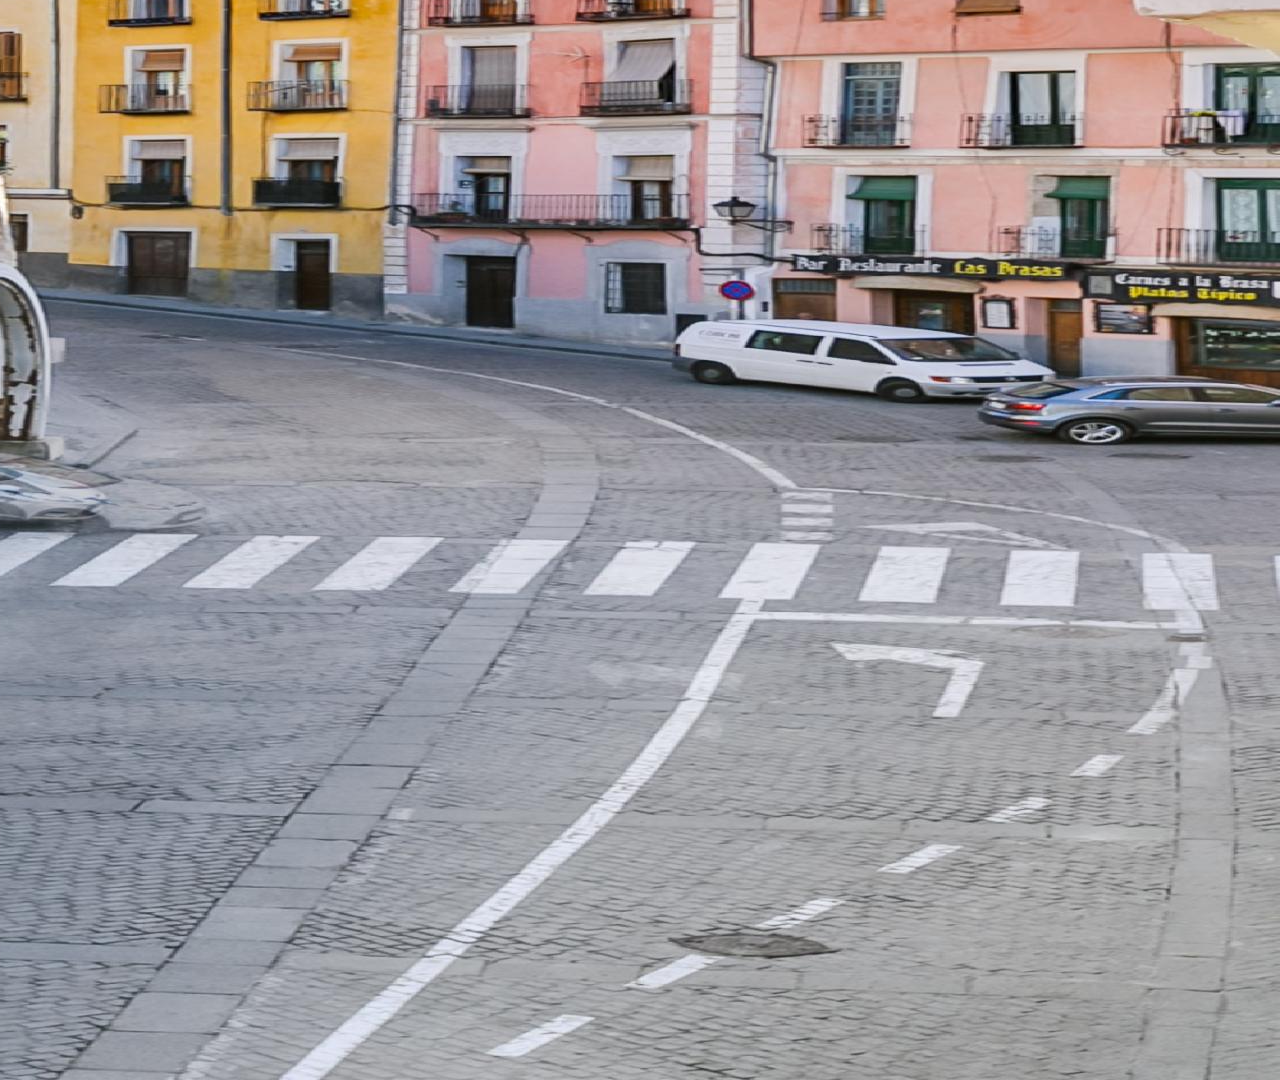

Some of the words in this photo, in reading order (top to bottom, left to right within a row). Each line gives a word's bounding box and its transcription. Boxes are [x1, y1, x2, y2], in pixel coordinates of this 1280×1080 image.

[796, 256, 827, 271] Bar
[837, 258, 942, 274] Restaurante
[997, 261, 1064, 277] Brasas
[1115, 273, 1171, 286] Carnes
[1178, 277, 1189, 287] a
[1195, 275, 1212, 287] la
[1219, 276, 1269, 289] Brasa
[1129, 286, 1189, 299] Platos
